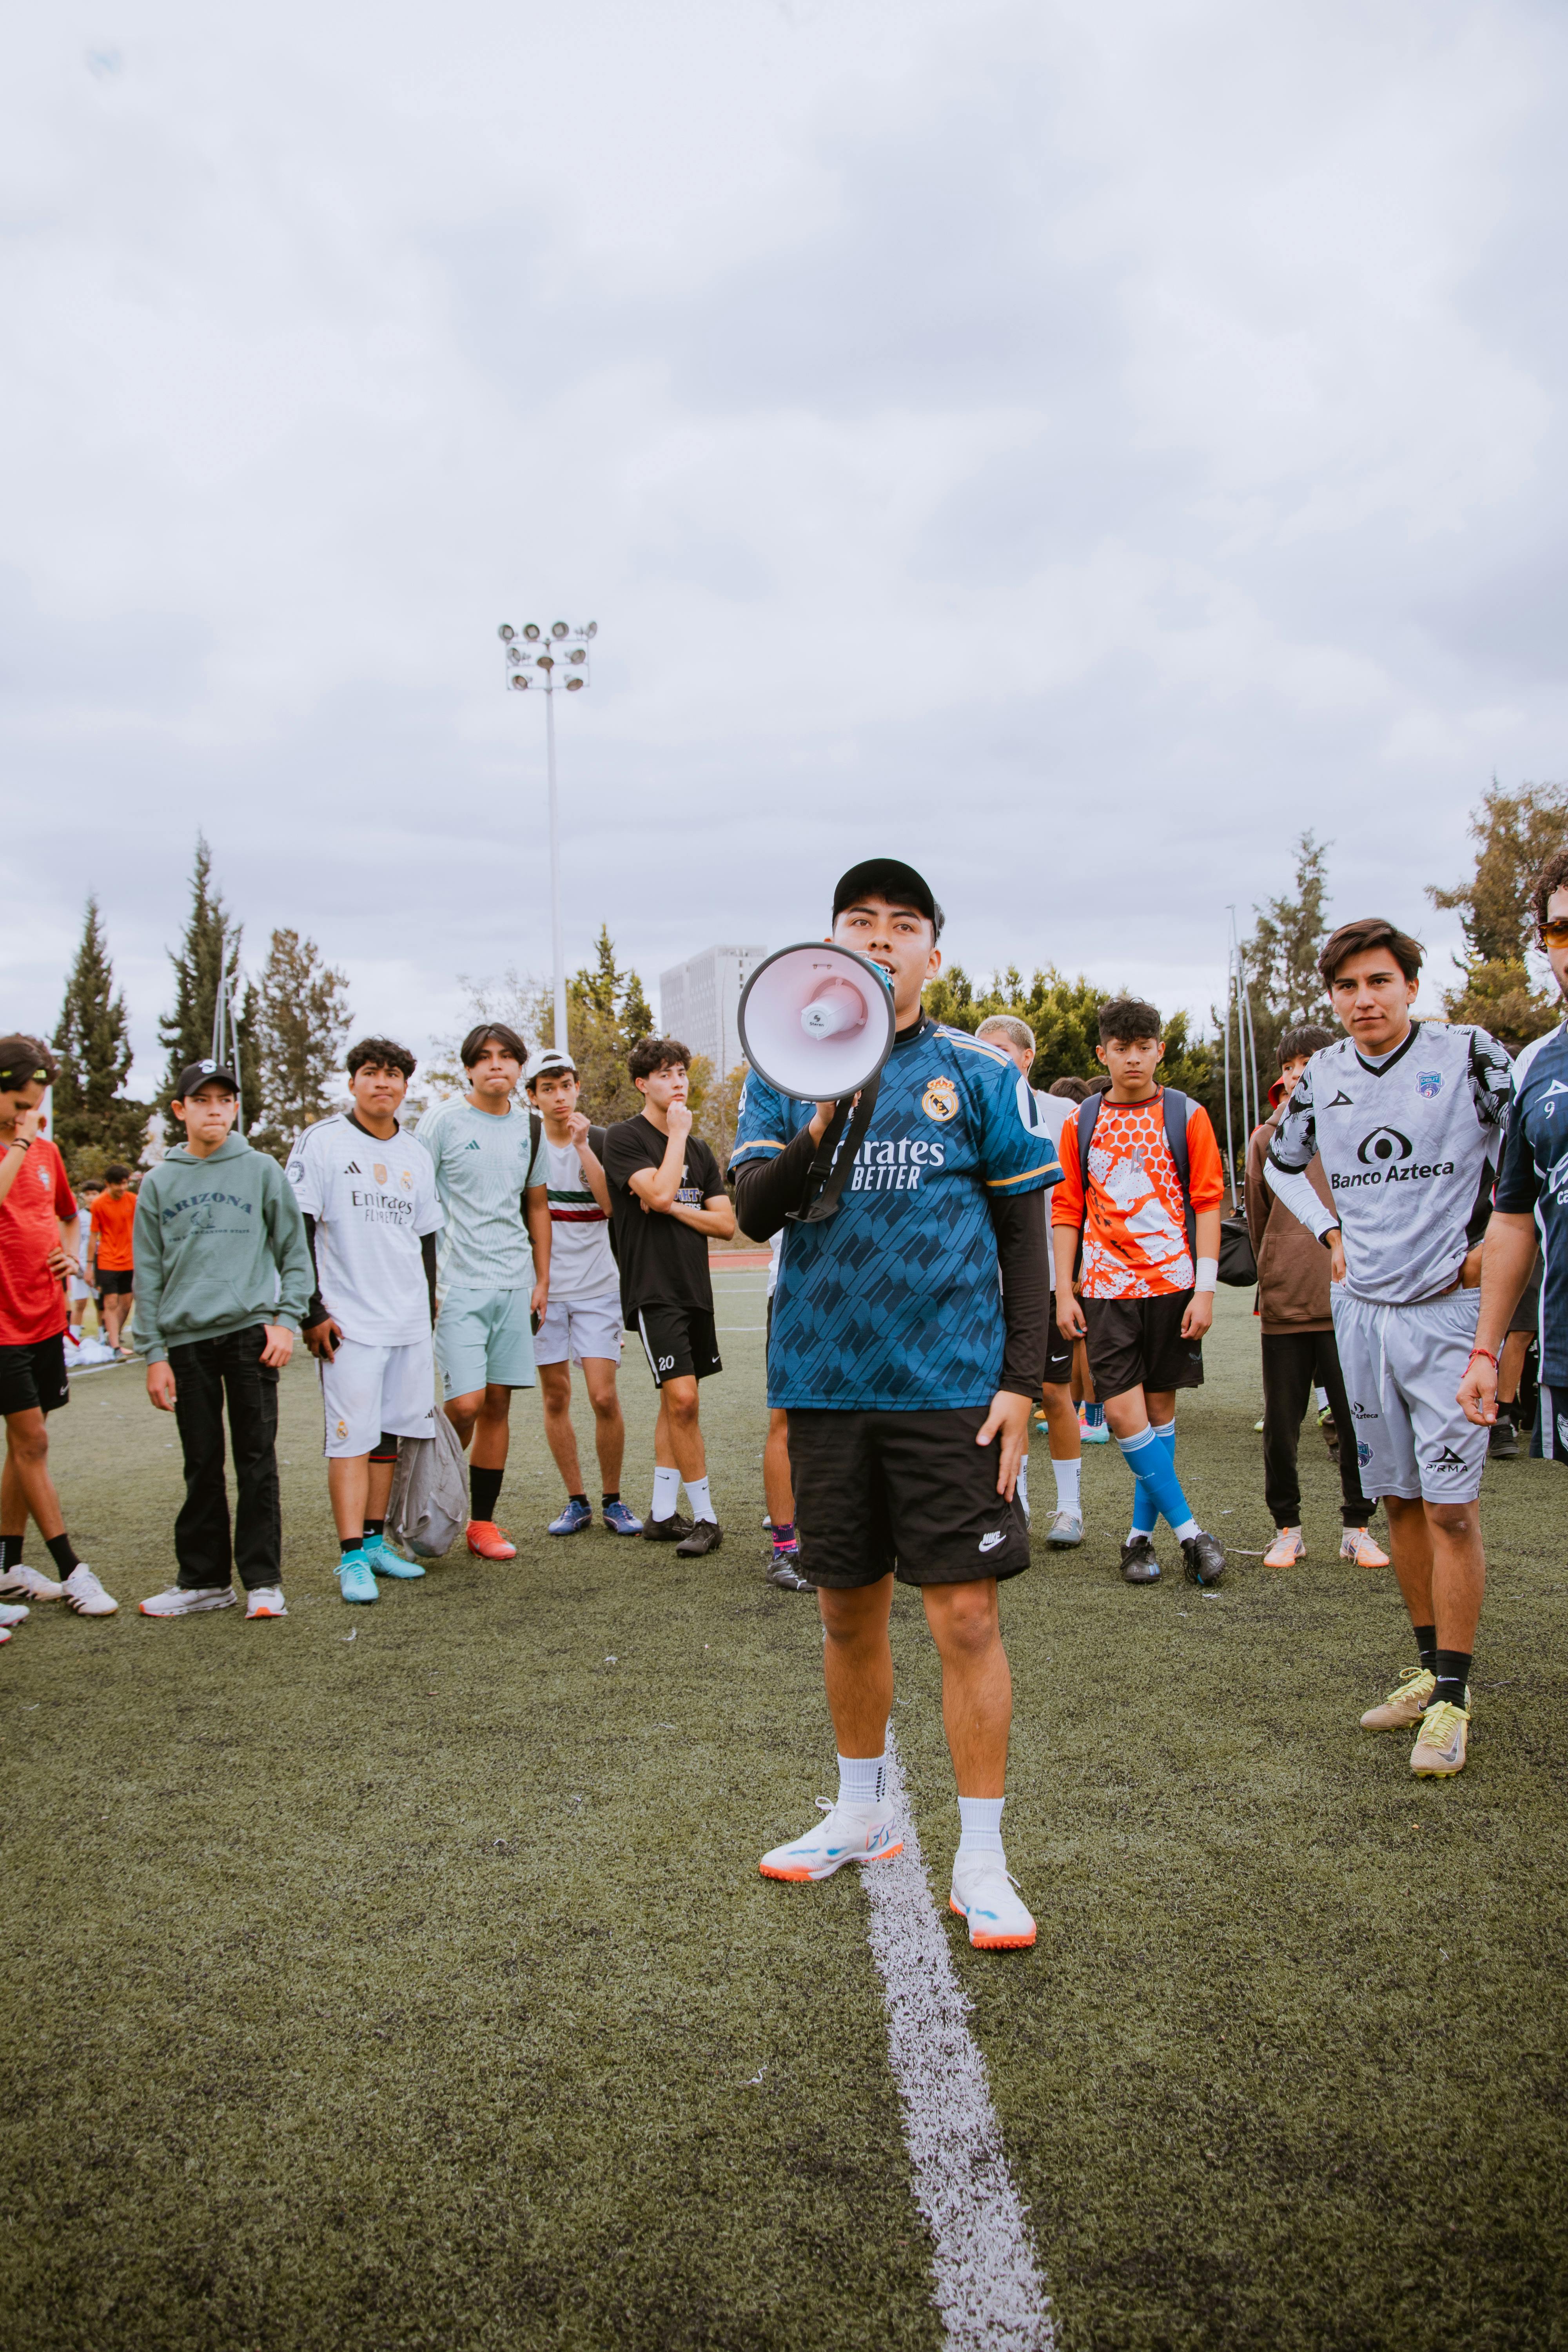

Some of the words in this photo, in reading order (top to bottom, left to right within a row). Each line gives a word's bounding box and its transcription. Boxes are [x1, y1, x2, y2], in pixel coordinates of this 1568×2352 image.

[1544, 1101, 1555, 1119] 9
[851, 1165, 920, 1191] BETTER
[1331, 1172, 1381, 1189] Banco
[1385, 1161, 1454, 1183] Azteca
[162, 1192, 252, 1225] ARIZONA
[659, 1355, 674, 1371] 20
[1426, 1463, 1468, 1472] PIRMA
[982, 1530, 1000, 1544] NIKE
